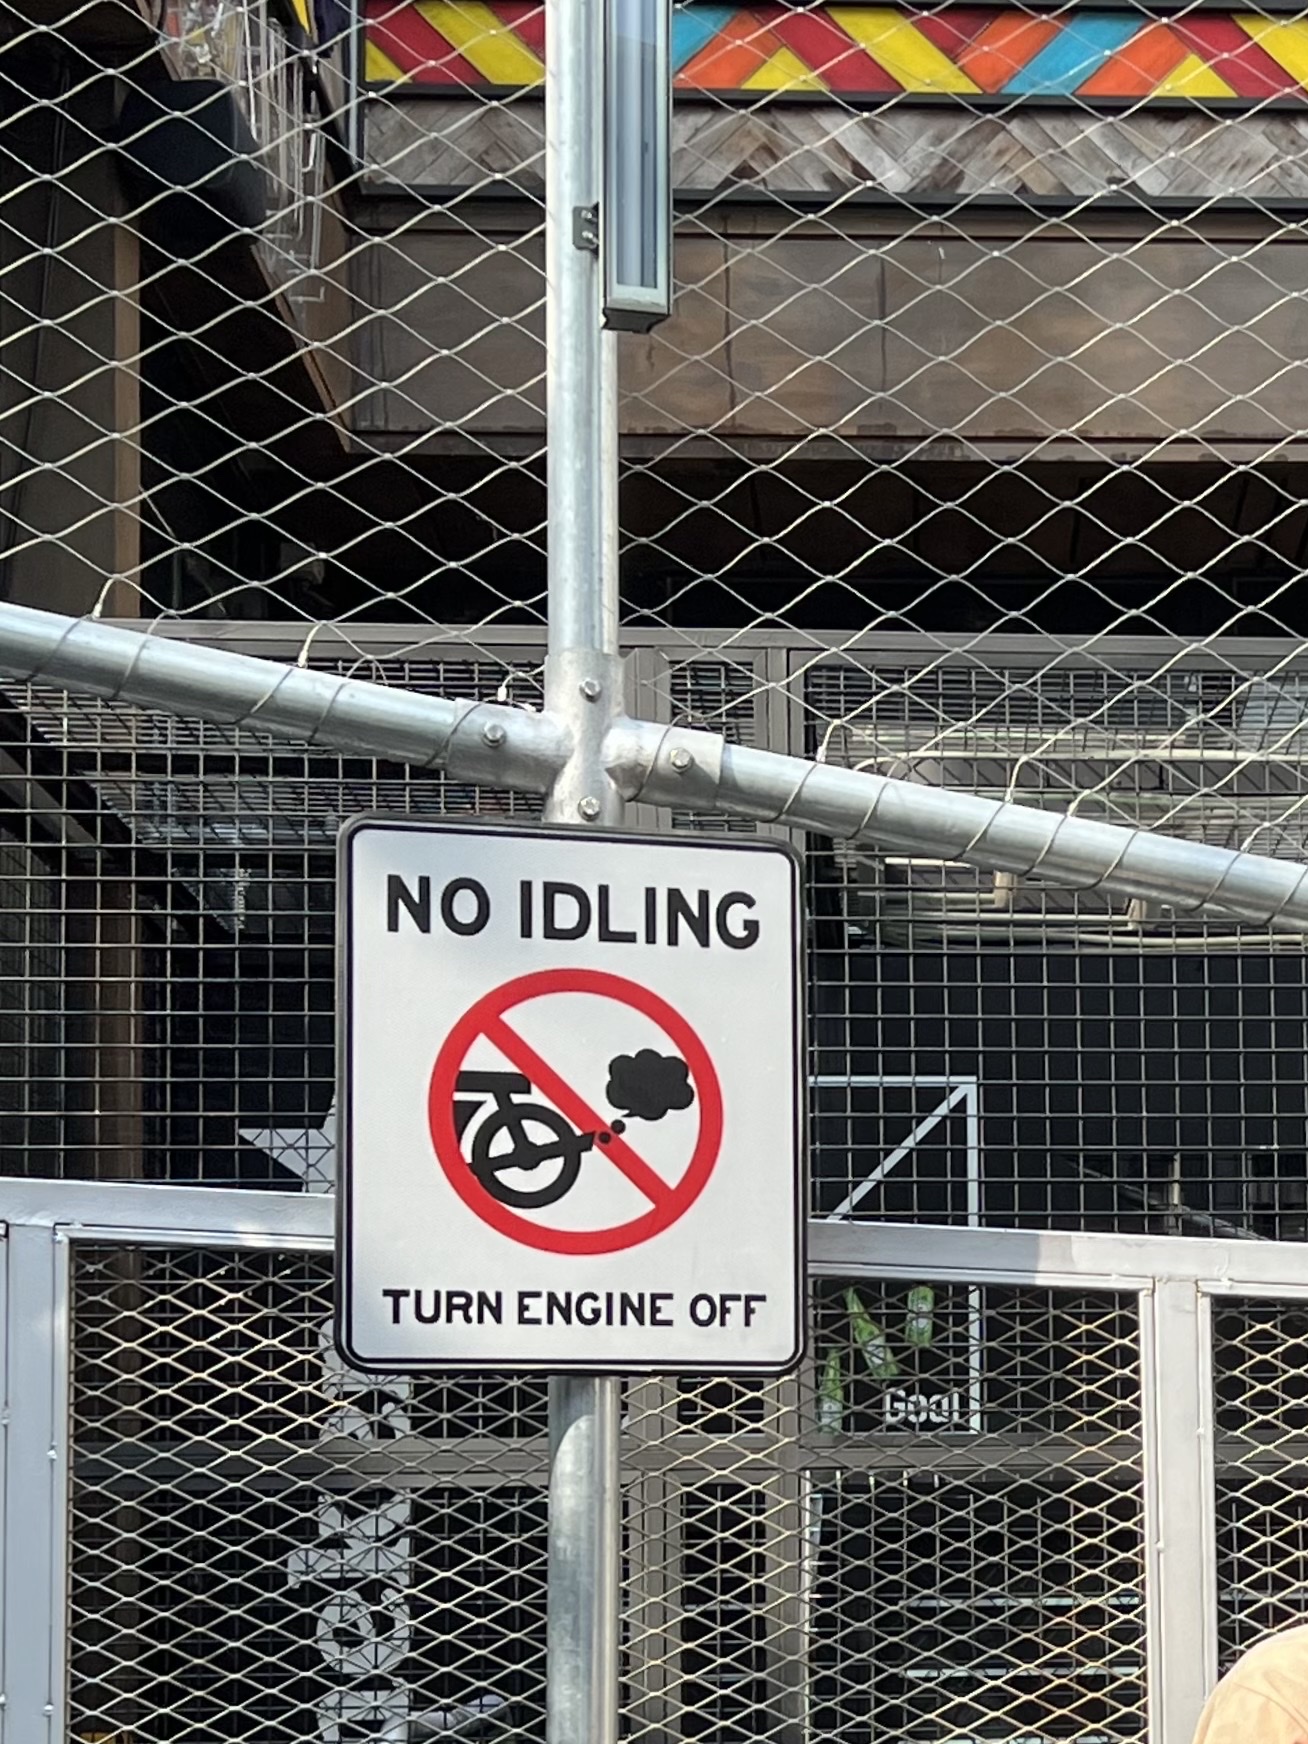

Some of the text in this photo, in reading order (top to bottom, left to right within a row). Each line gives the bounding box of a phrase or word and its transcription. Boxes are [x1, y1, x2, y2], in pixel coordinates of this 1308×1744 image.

[387, 874, 760, 949] NO IDLING
[382, 1288, 767, 1328] TURN ENGINE OFF
[885, 1388, 960, 1424] Goal
